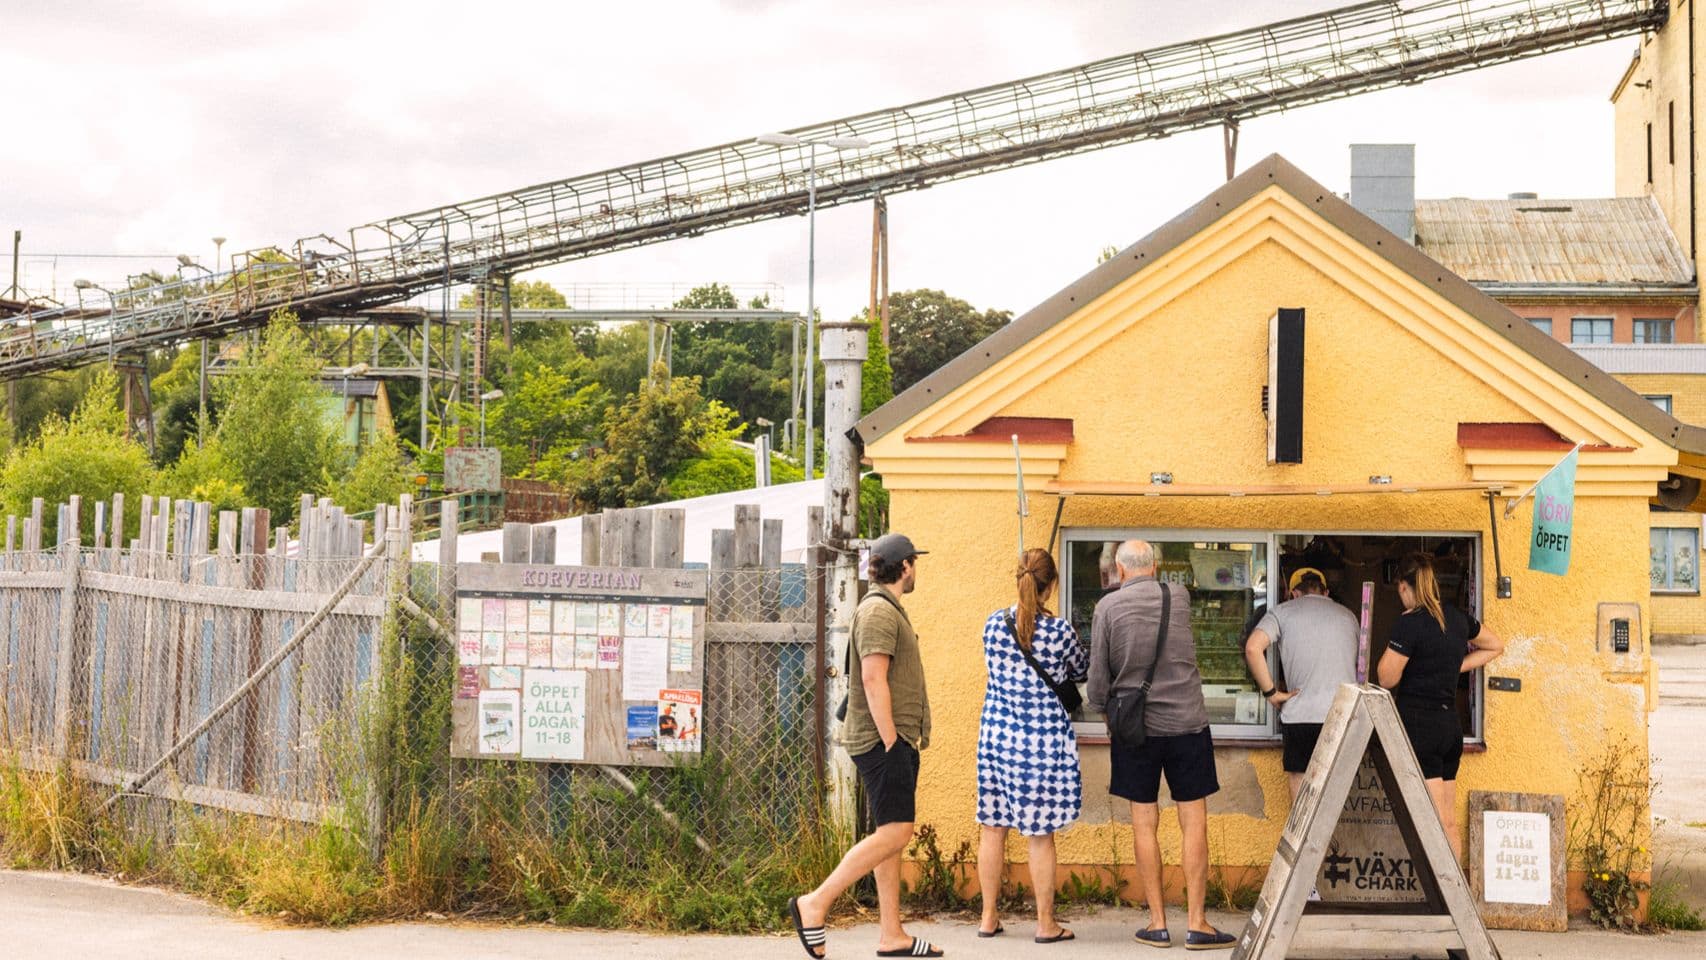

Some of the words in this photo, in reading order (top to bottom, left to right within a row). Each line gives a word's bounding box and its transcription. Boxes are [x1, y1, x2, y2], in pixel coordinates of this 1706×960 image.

[530, 681, 580, 698] ÖPPET
[535, 700, 573, 714] ALLA
[527, 715, 580, 729] DAGAR
[535, 731, 572, 745] 11-18
[1500, 835, 1533, 849] Alla
[1354, 851, 1414, 877] VÄXT
[1496, 851, 1539, 868] dagar
[1495, 867, 1541, 882] 11-18
[1355, 877, 1418, 891] CHARK
